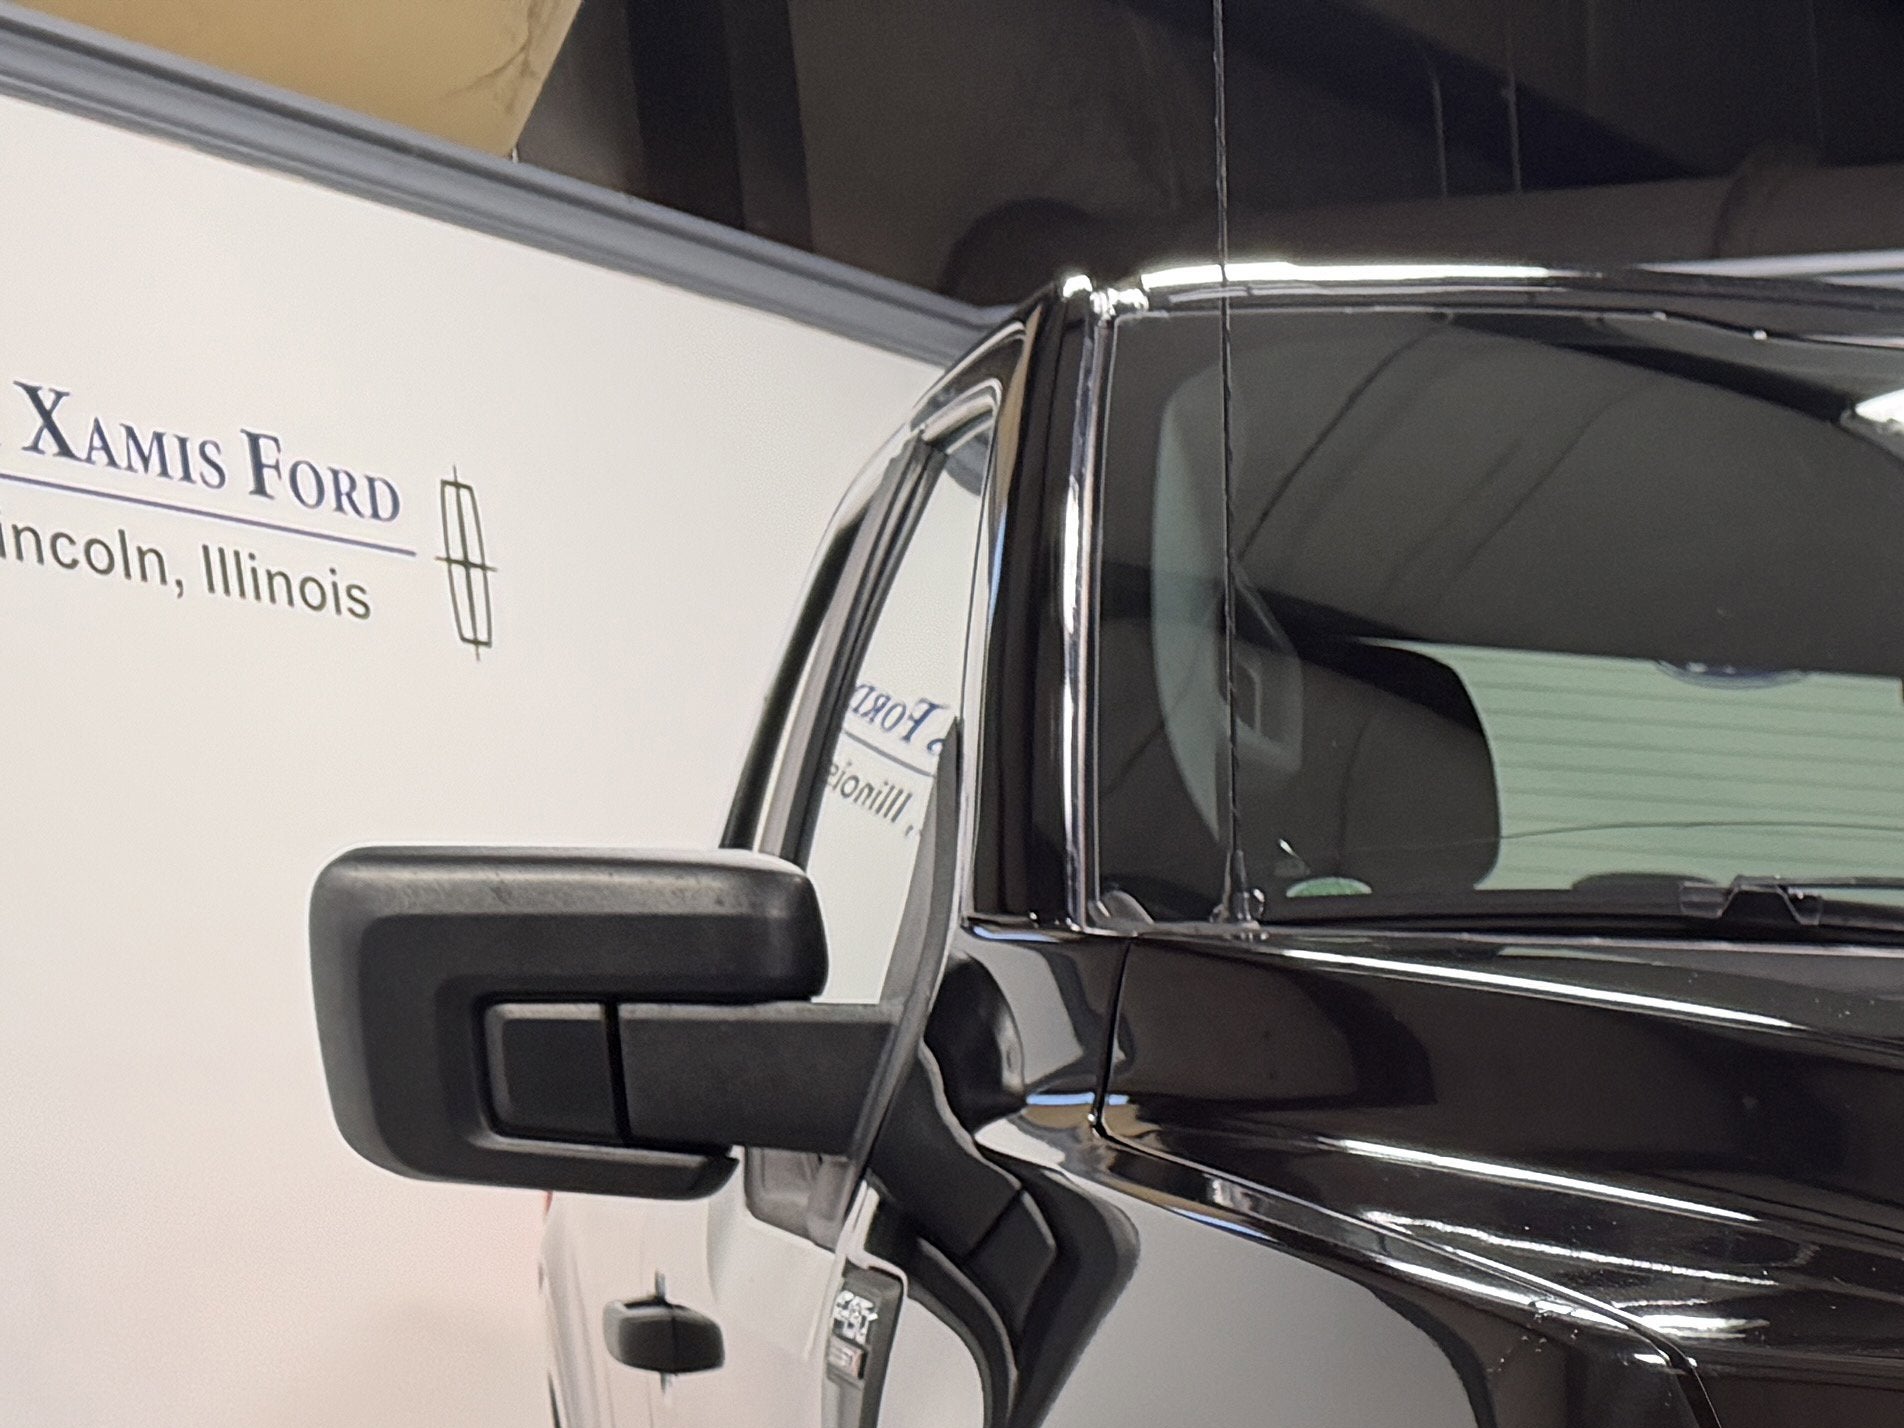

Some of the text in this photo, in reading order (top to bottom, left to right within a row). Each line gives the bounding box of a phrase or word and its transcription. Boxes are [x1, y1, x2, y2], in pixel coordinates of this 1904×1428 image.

[13, 380, 400, 522] XAMIS FORD
[202, 544, 370, 619] Illinois
